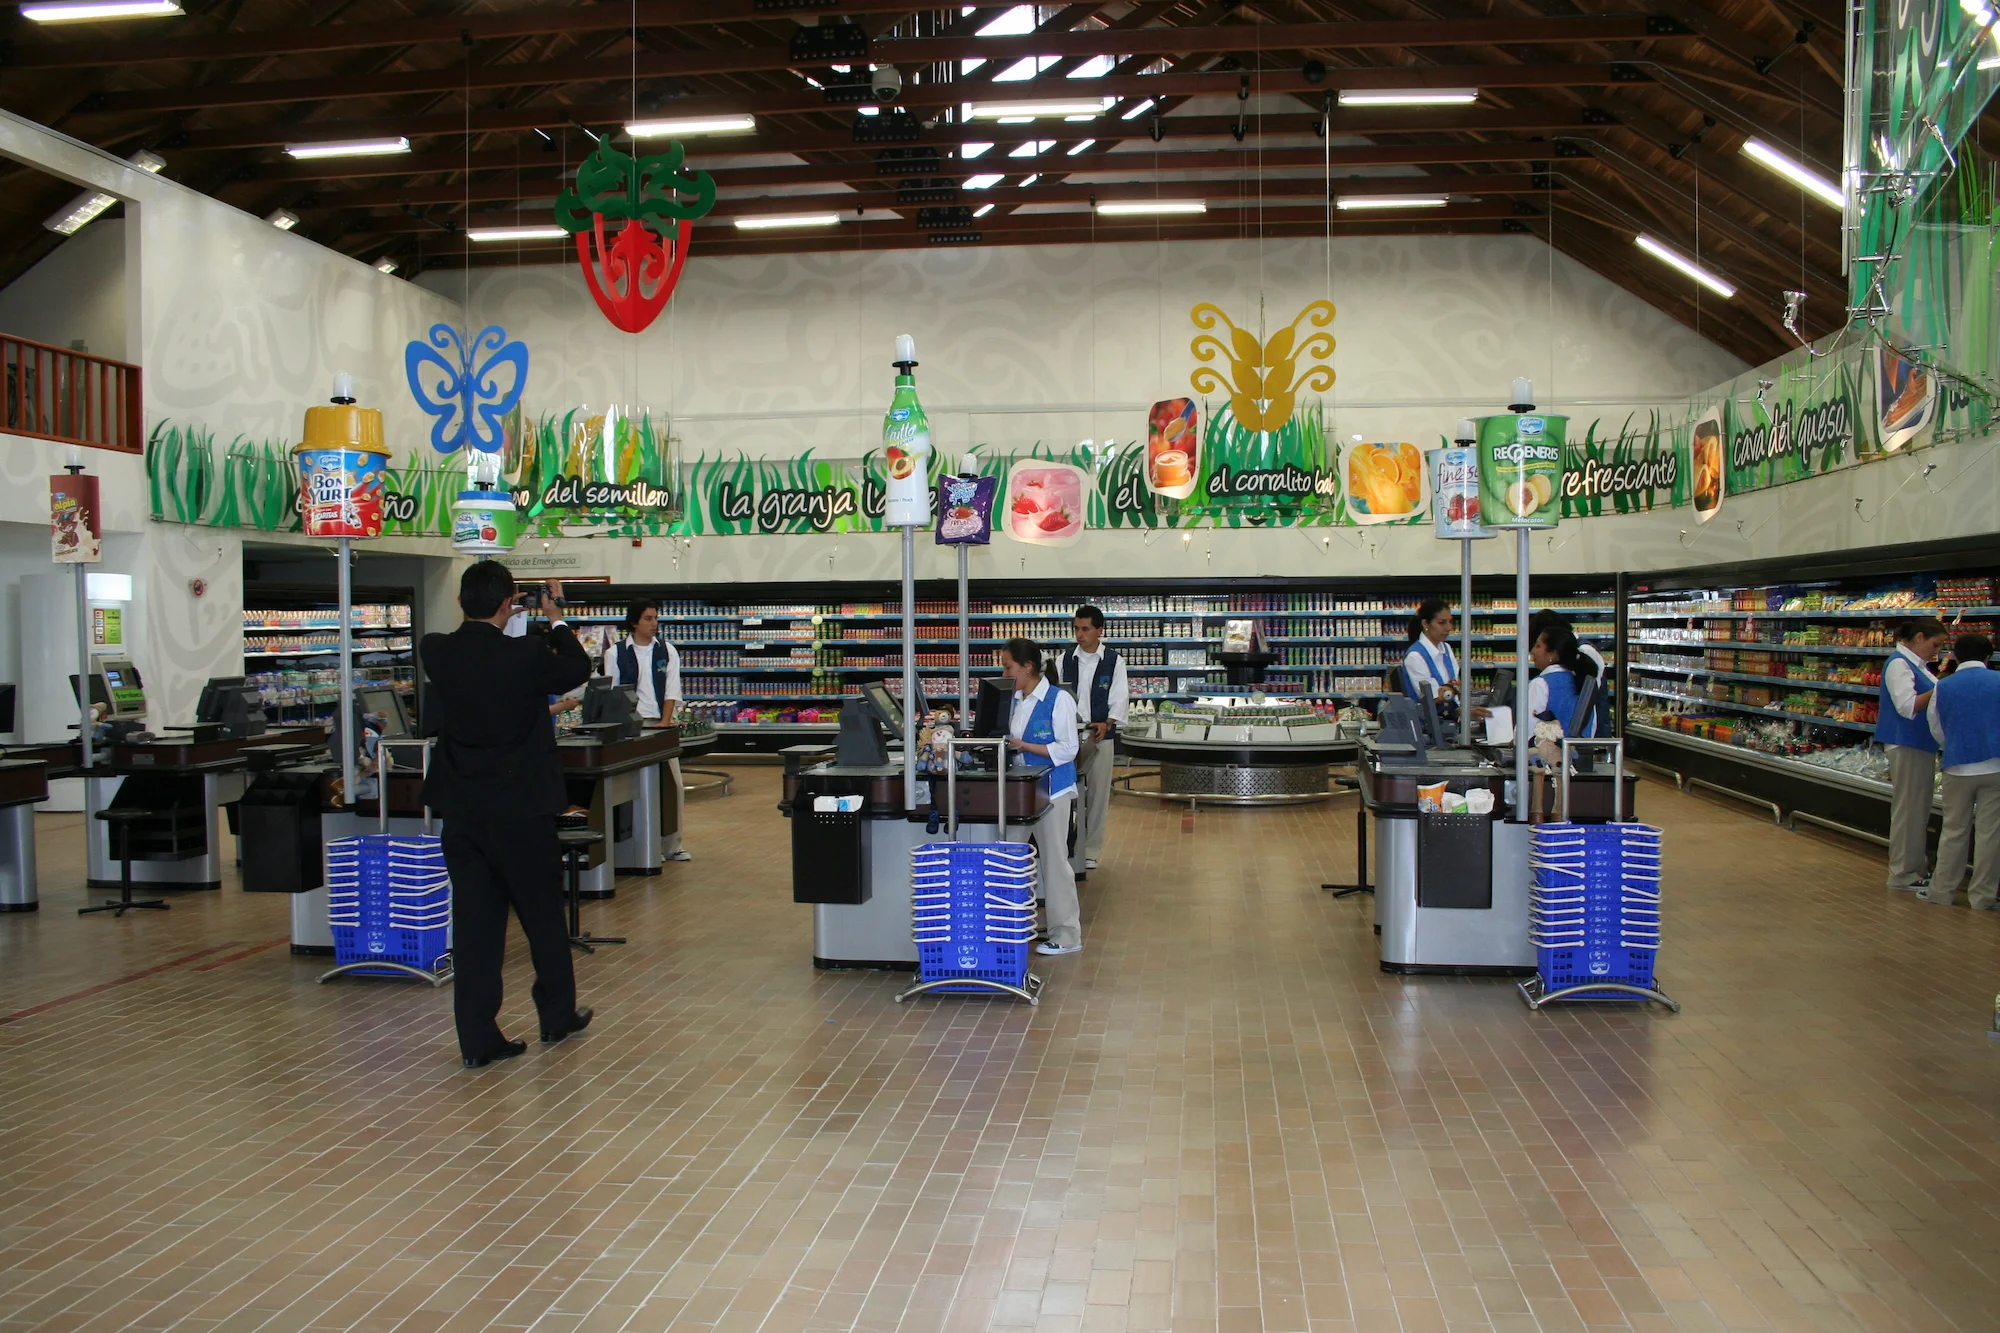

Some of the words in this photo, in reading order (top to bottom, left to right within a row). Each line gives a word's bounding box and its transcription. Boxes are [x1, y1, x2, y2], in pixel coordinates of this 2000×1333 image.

[1733, 428, 1766, 467] cava
[1767, 404, 1792, 458] del
[1797, 403, 1845, 464] queso
[1210, 468, 1230, 493] el
[1235, 467, 1311, 492] corralito
[1560, 455, 1677, 497] refrescante
[308, 487, 352, 506] YURT
[545, 479, 580, 504] del
[585, 482, 669, 507] semillero
[722, 485, 751, 517] la
[761, 489, 854, 530] granja
[1115, 477, 1142, 509] el
[522, 557, 531, 566] de
[532, 556, 577, 568] Emergencia
